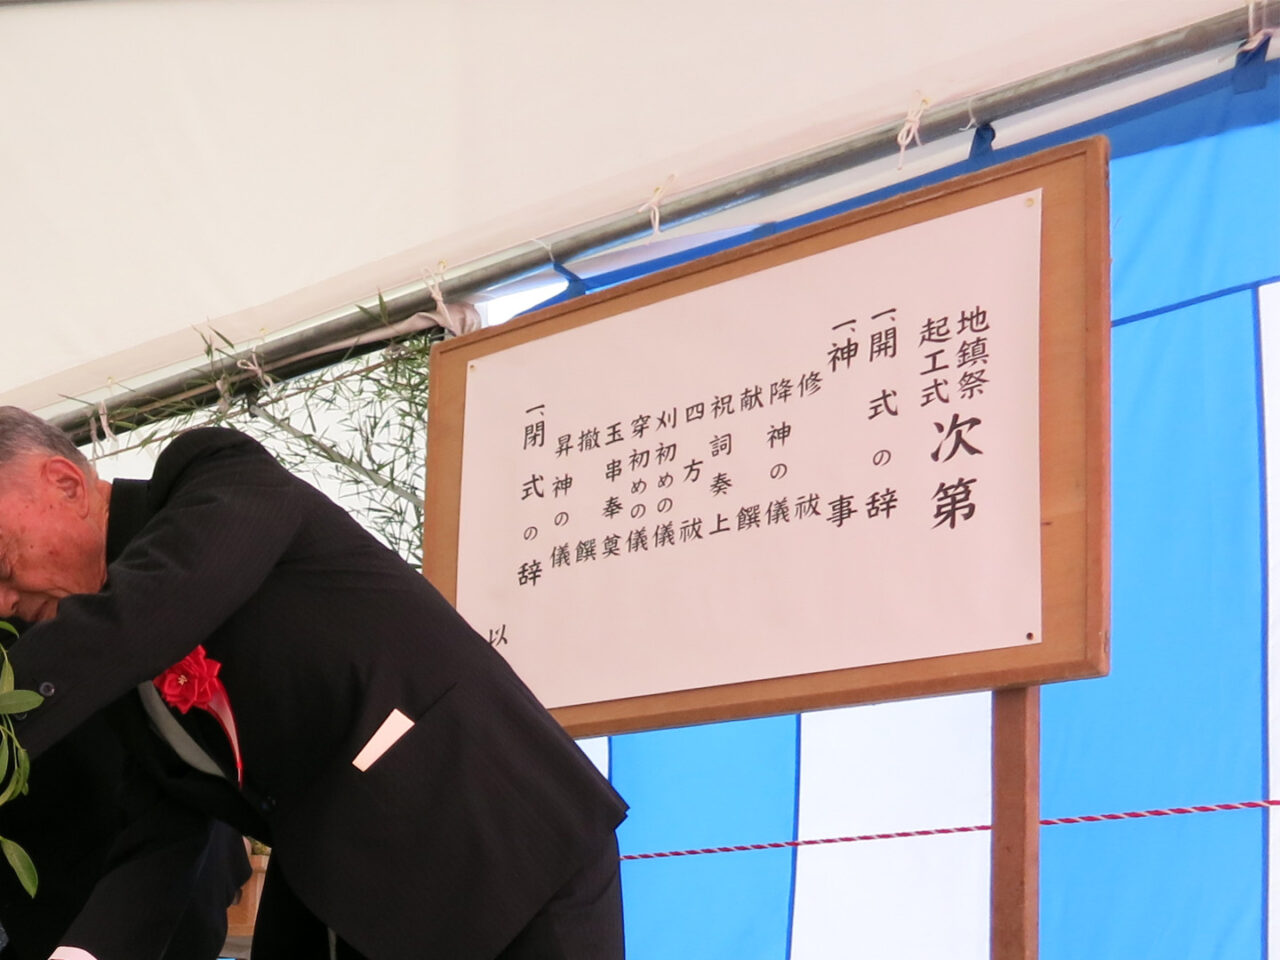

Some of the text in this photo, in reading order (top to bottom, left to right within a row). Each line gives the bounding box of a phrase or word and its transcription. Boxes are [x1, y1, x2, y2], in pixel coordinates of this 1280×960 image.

[826, 318, 859, 528] 一、神事
[865, 307, 899, 520] 一、開式の辞
[919, 316, 952, 408] 起工式
[956, 305, 991, 401] 地鎮祭
[517, 404, 546, 587] 一、閉式の辞
[549, 433, 574, 569] 昇神の儀
[575, 427, 602, 564] 撤饌
[602, 421, 624, 559] 玉串奉奠
[626, 414, 651, 553] 穿初めの儀
[652, 407, 677, 549] 刈初めの儀
[679, 402, 705, 544] 四方祓
[709, 394, 736, 536] 祝詞奏上
[736, 384, 765, 532] 献饌
[765, 377, 794, 526] 降神の儀
[793, 370, 823, 521] 修祓
[930, 413, 984, 531] 次第
